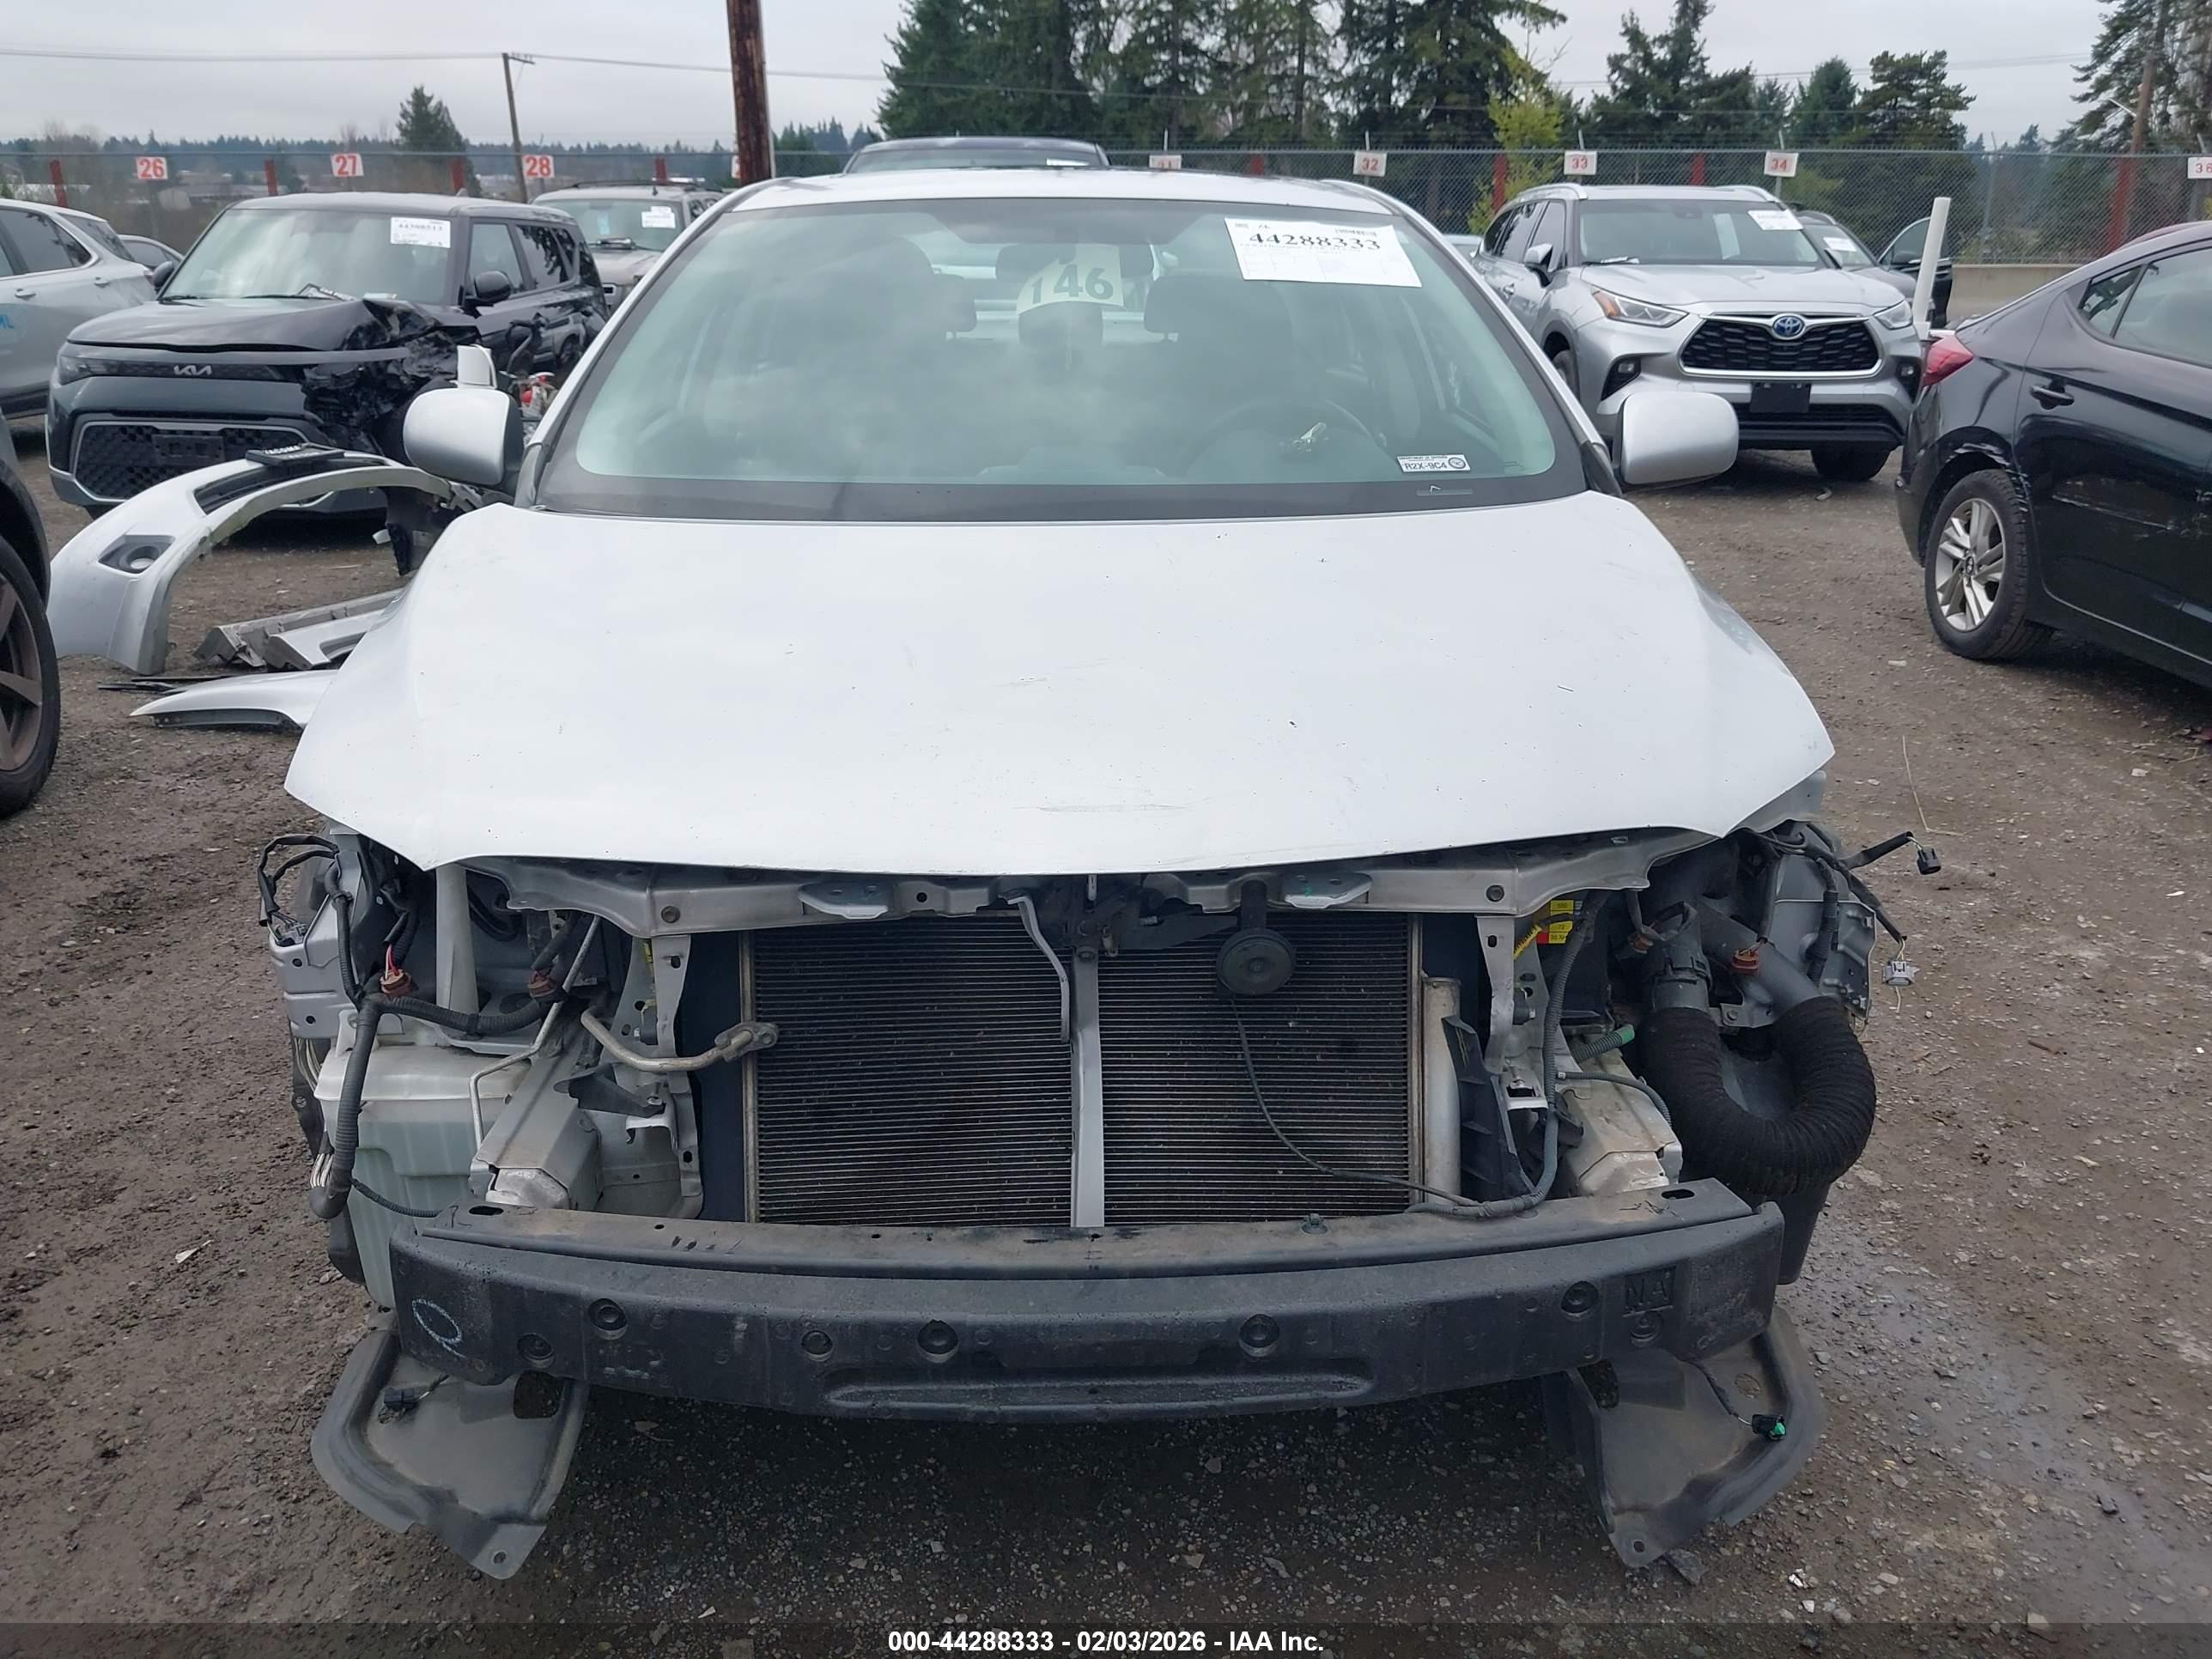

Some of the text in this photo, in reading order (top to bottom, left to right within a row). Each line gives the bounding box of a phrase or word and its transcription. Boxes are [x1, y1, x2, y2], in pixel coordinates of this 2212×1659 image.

[139, 159, 165, 179] 26
[336, 155, 358, 175] 27
[526, 156, 550, 177] 28
[1362, 158, 1379, 172] 32
[1571, 158, 1588, 170] 33
[1771, 159, 1787, 171] 34
[1249, 233, 1381, 251] 44288333
[1030, 264, 1114, 305] 146
[173, 365, 212, 376] KIA
[1404, 462, 1448, 471] R2X-9C4
